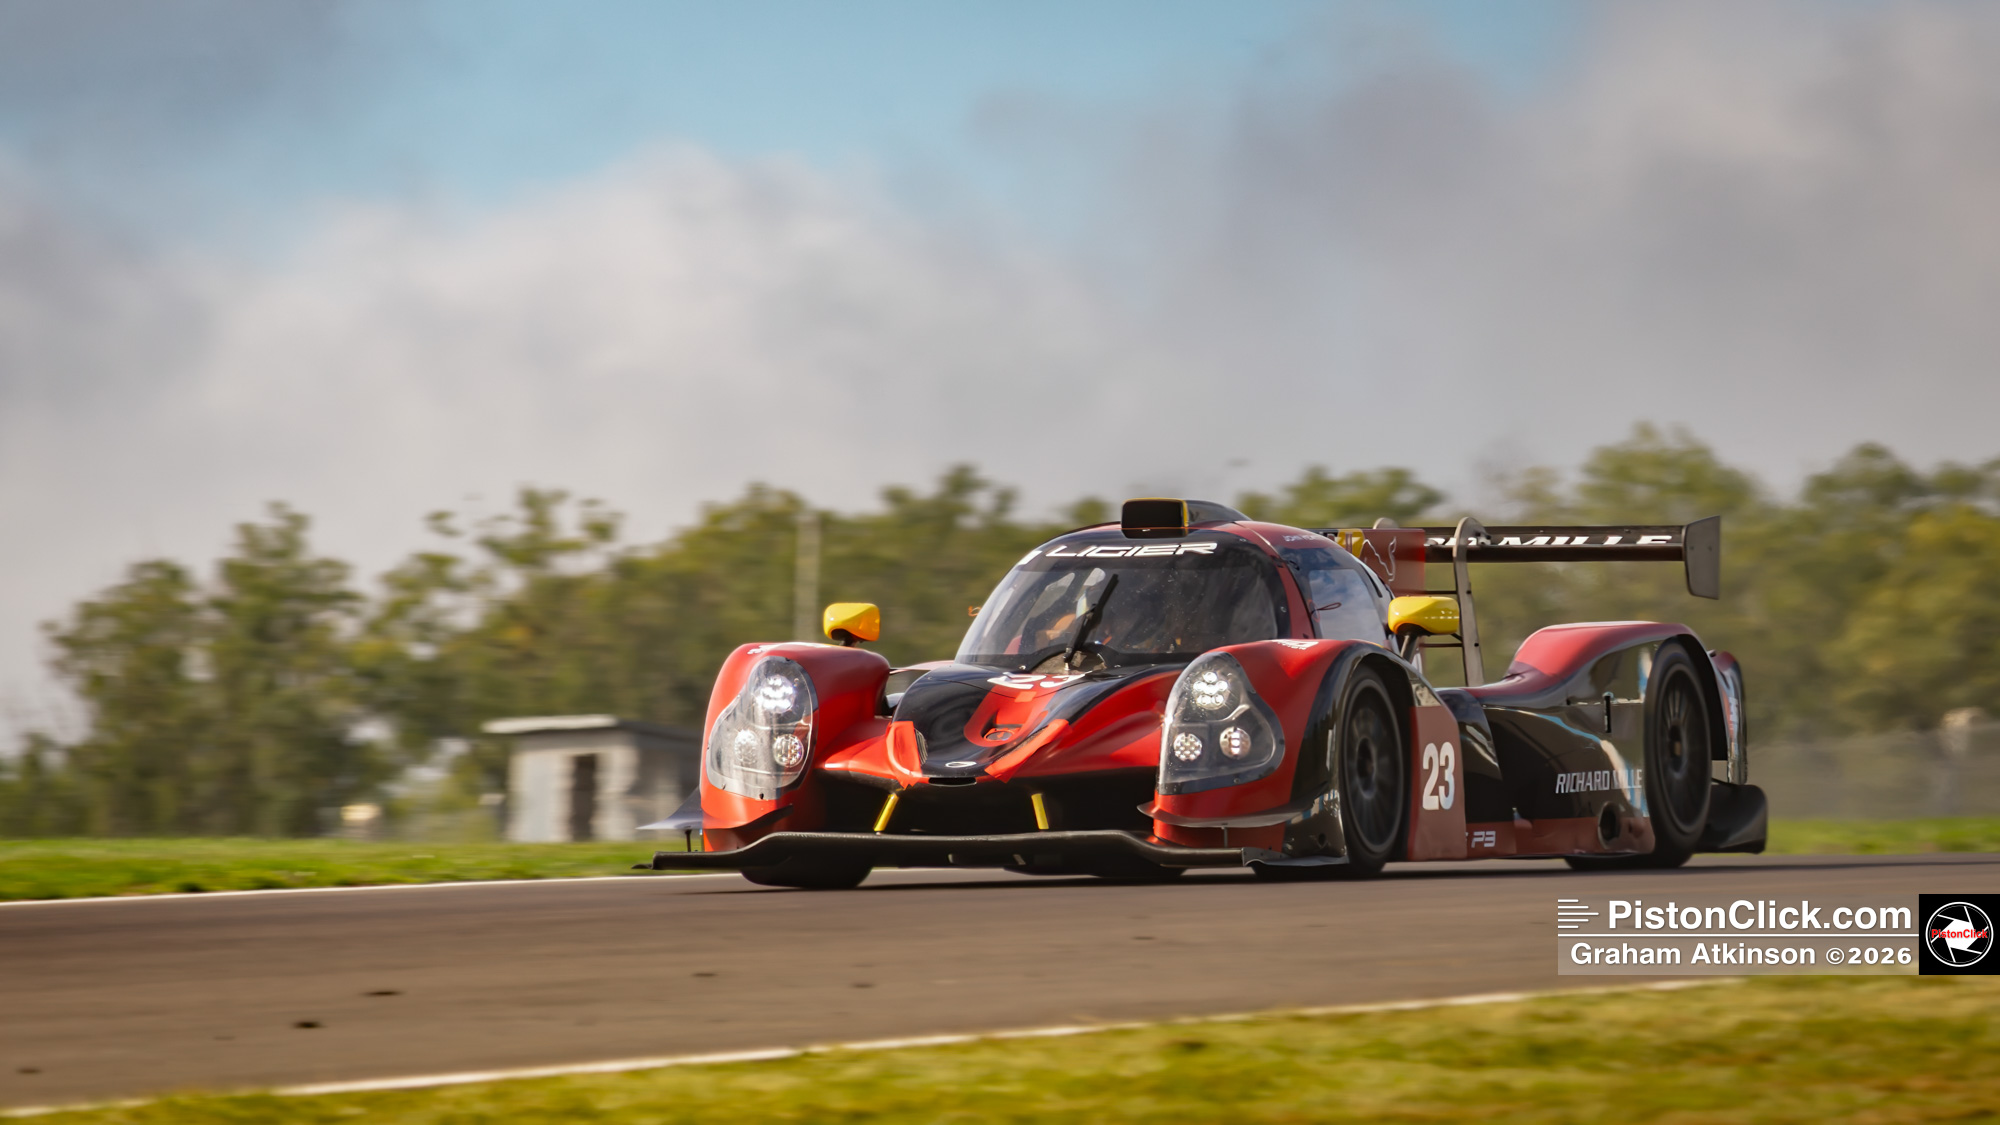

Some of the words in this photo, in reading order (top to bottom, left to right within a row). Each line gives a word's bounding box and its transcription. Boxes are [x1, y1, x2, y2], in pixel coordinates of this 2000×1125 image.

[1045, 541, 1217, 558] LIGIER
[987, 672, 1087, 690] 23
[1421, 741, 1456, 811] 23
[1555, 770, 1610, 794] RICHARD
[1471, 830, 1496, 848] P3
